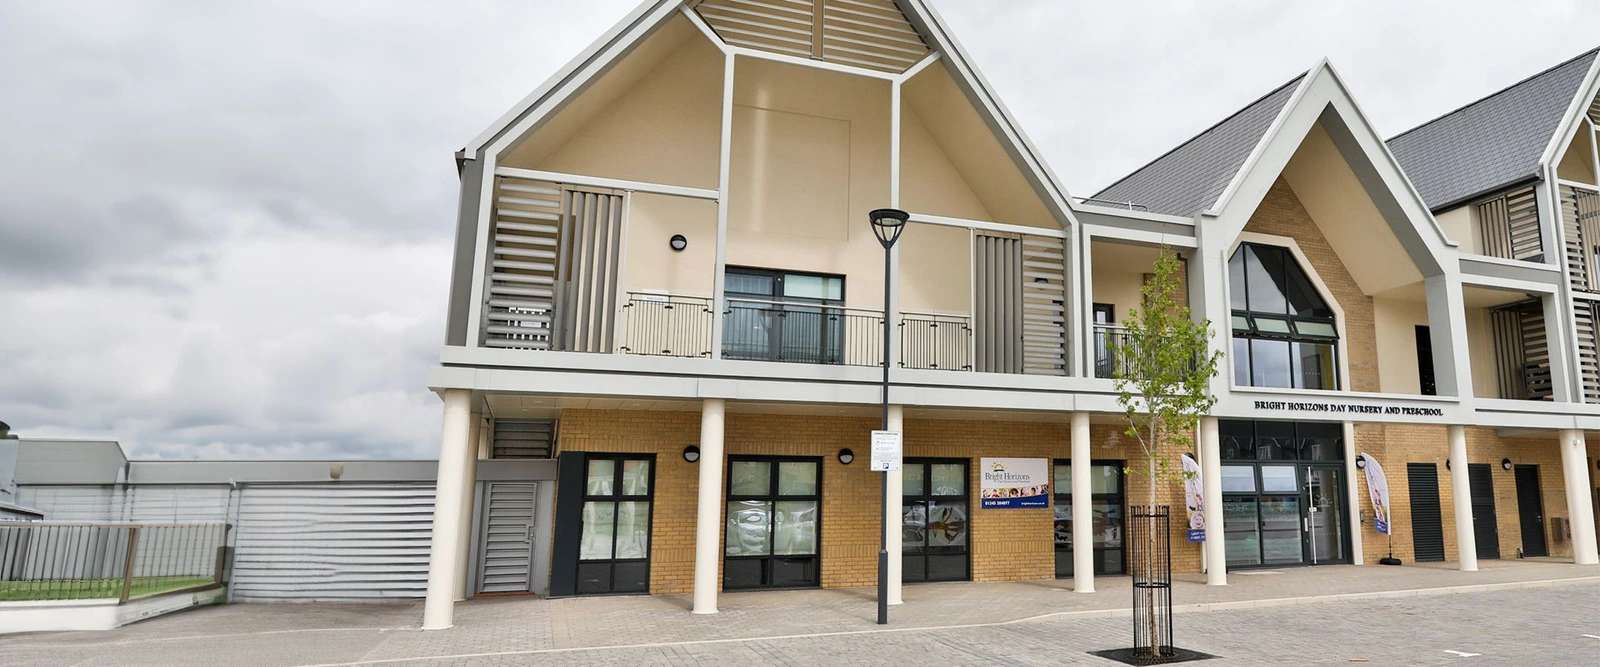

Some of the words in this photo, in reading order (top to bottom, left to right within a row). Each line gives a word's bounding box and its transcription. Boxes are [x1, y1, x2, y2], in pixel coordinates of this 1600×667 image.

[1254, 401, 1286, 410] BRIGHT
[1287, 402, 1329, 412] HORIZONS
[1330, 404, 1347, 412] DAY
[1348, 405, 1383, 414] NURSERY
[1384, 406, 1400, 415] AND
[1401, 407, 1444, 416] PRESCHOOL
[985, 472, 1003, 482] Bright
[1004, 472, 1030, 480] Horizons
